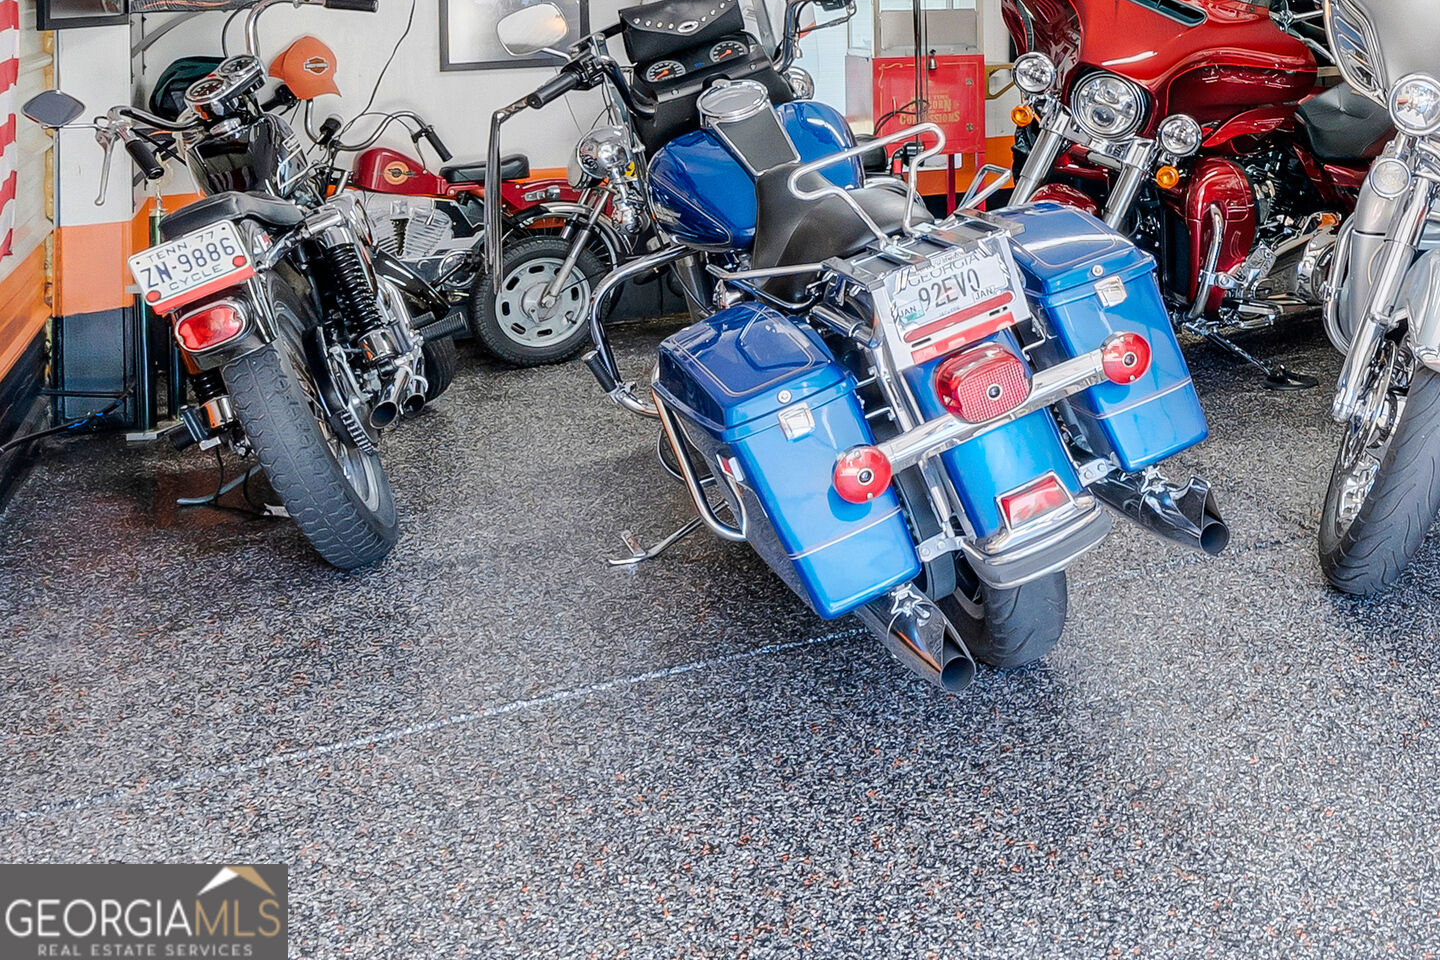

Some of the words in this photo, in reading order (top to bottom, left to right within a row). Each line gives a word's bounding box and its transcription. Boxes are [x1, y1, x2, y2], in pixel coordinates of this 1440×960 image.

[195, 231, 215, 243] 77
[140, 237, 236, 289] ZN-9886
[908, 255, 981, 286] GEORGIA
[169, 263, 225, 291] CYCLE
[976, 288, 994, 301] JAN
[900, 305, 917, 317] JAN
